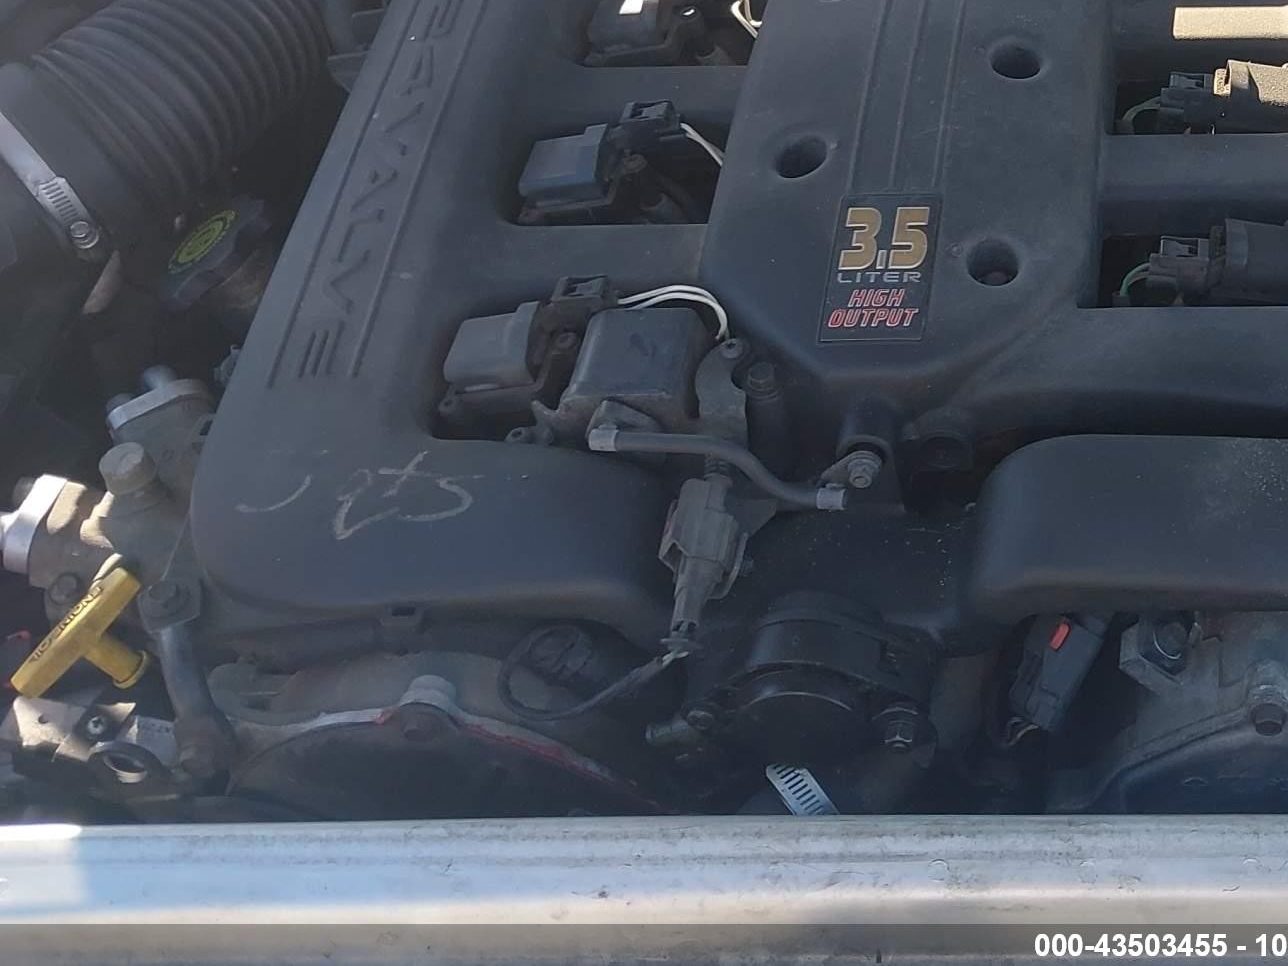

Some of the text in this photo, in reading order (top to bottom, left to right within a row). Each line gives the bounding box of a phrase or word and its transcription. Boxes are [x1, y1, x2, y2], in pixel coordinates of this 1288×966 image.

[838, 206, 931, 270] 3.5
[836, 271, 922, 283] LITER
[847, 288, 906, 307] HIGH
[827, 308, 919, 328] OUTPUT
